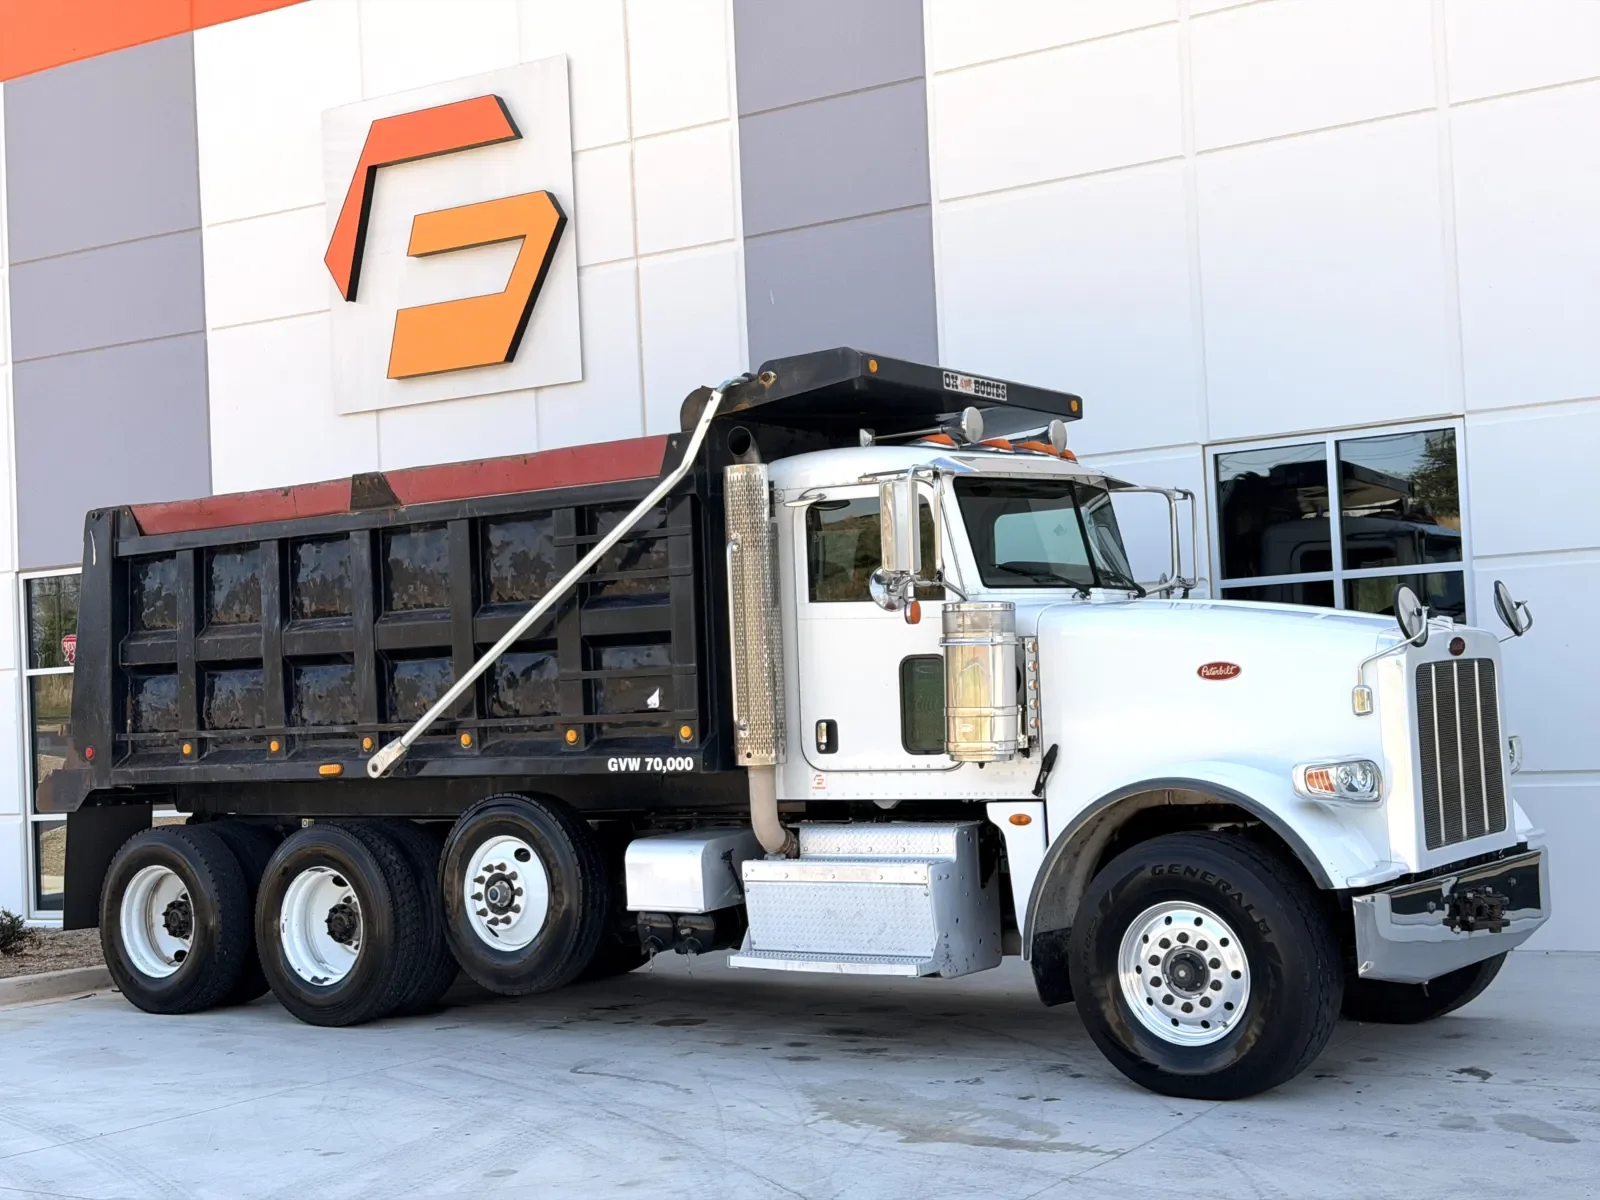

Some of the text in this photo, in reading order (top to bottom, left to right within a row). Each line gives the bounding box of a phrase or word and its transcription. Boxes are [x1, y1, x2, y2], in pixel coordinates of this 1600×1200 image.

[943, 373, 1006, 399] OX BODIES
[1201, 665, 1236, 677] Peterbilt
[607, 757, 693, 773] GVW 70,000
[1150, 863, 1258, 917] GENERAL
